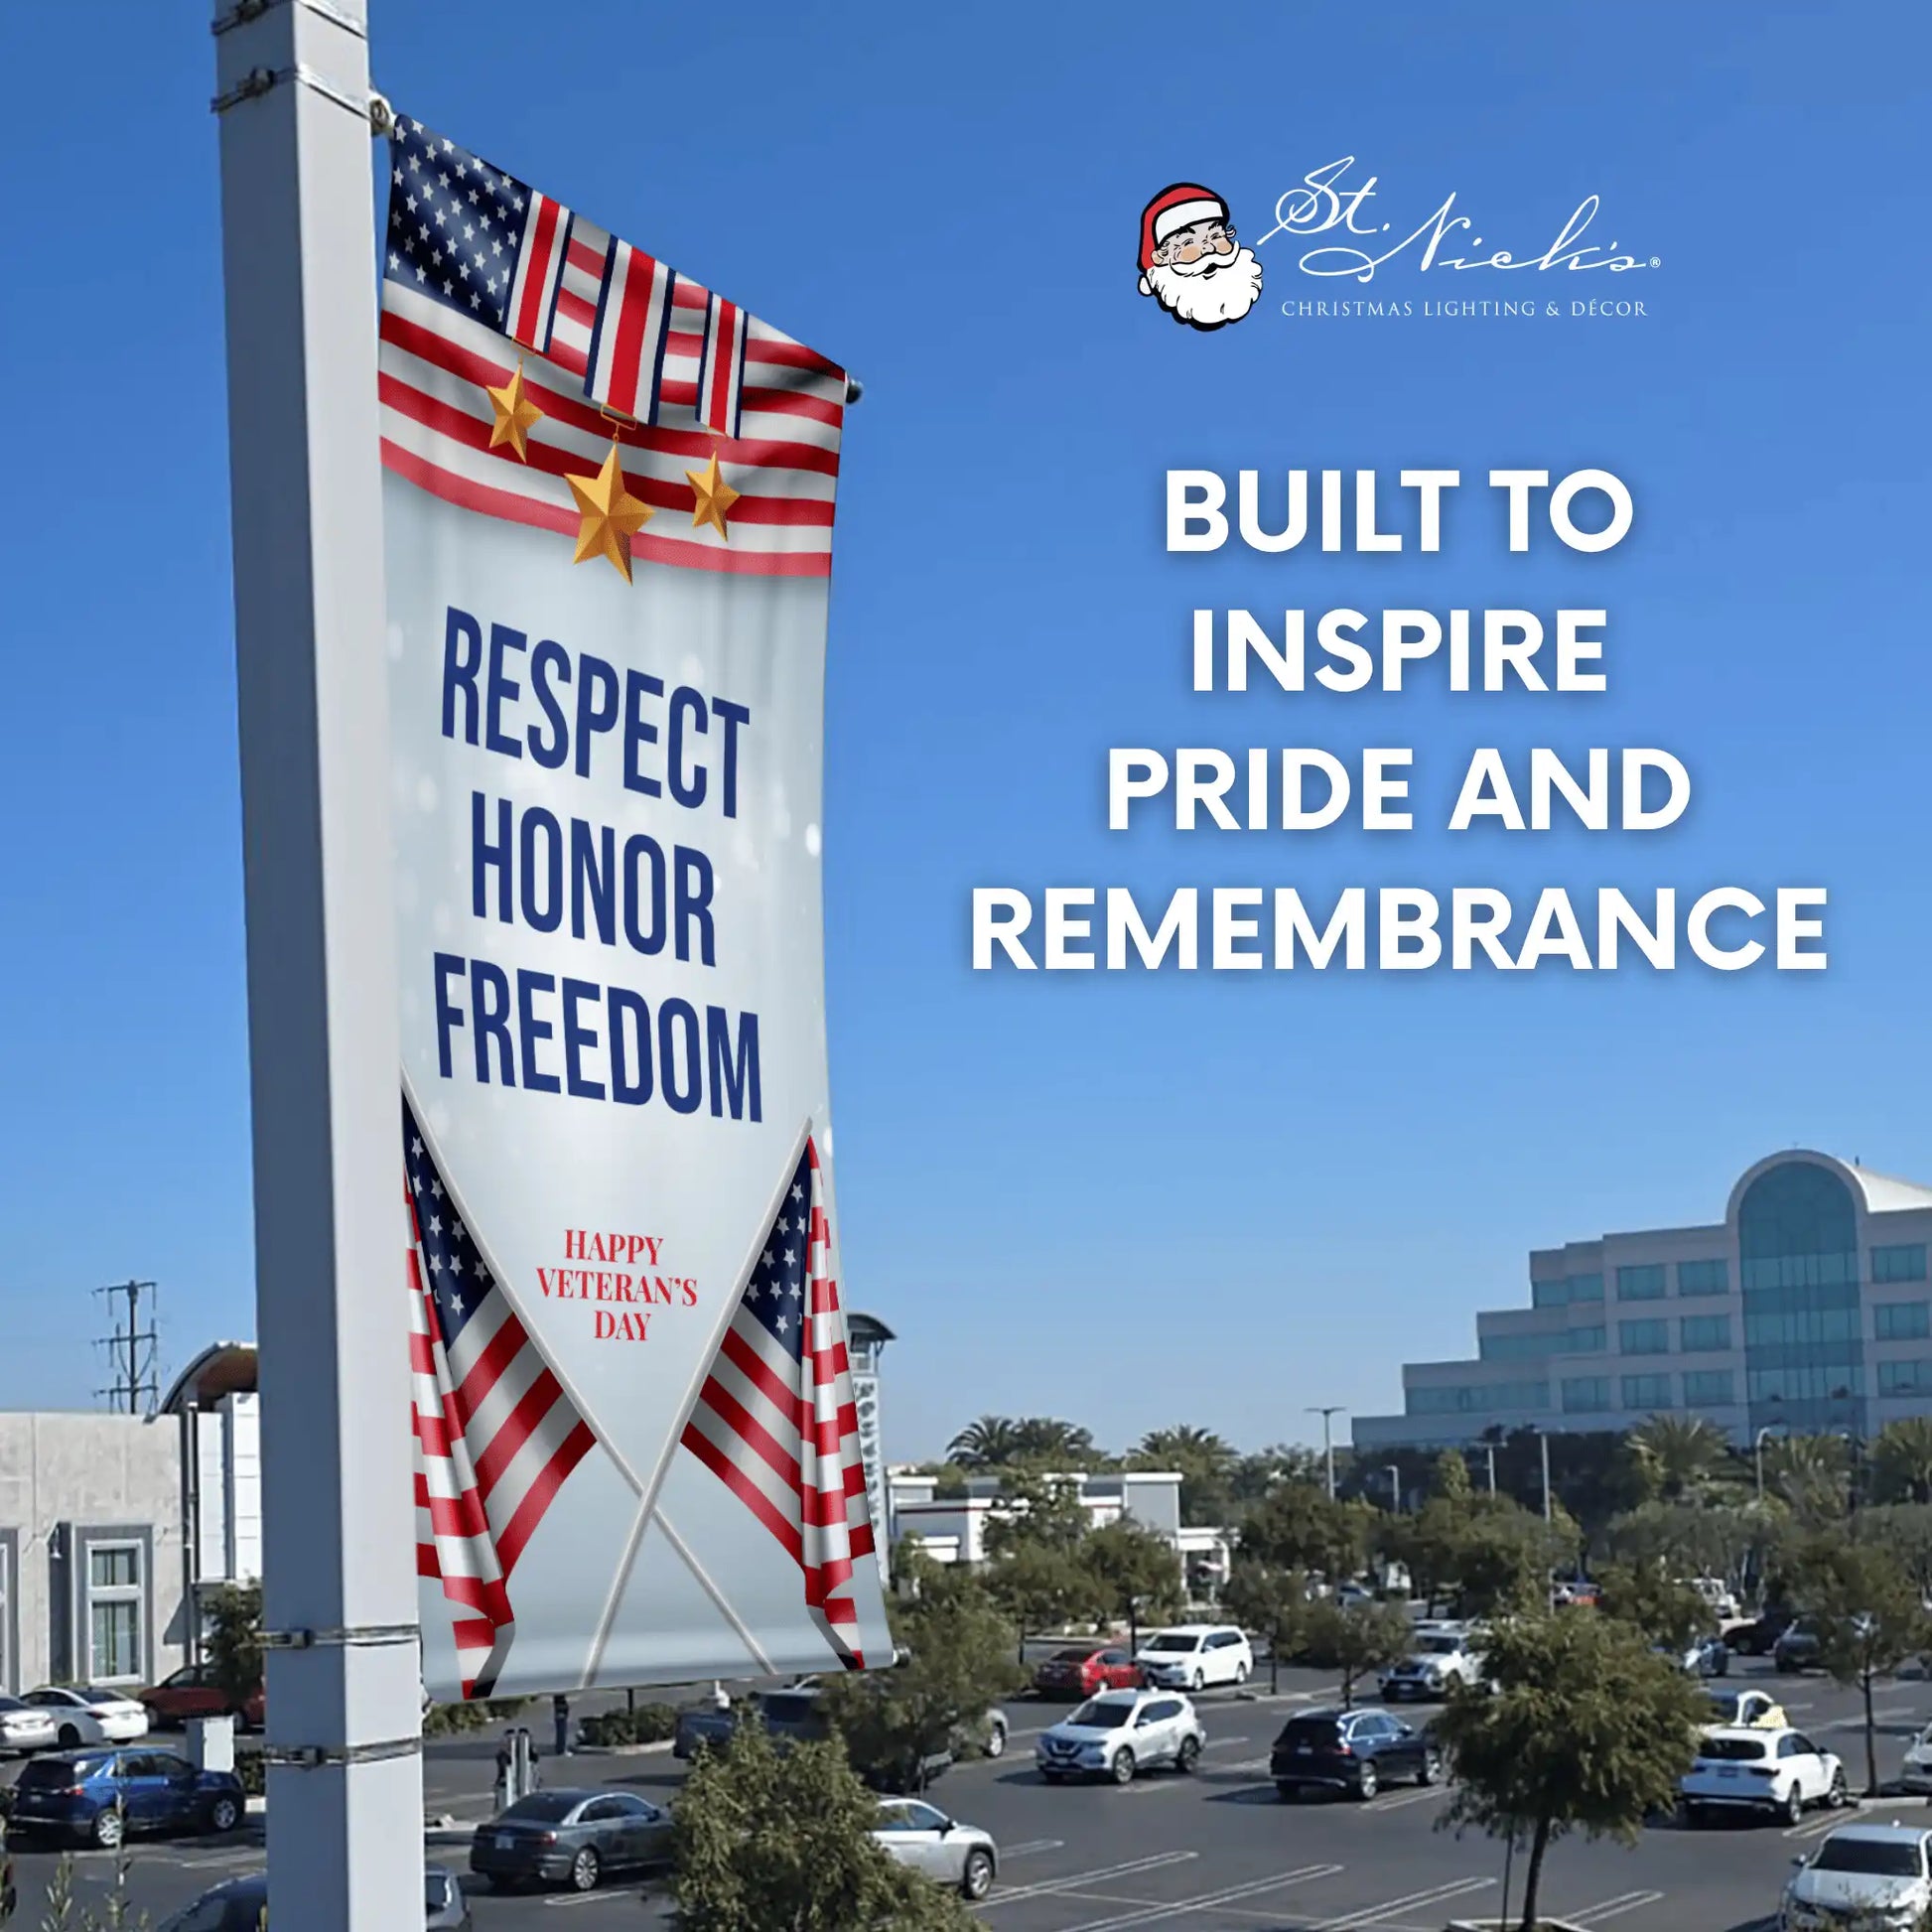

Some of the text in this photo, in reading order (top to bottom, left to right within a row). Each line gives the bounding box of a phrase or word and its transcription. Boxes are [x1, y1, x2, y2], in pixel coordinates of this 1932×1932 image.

[441, 606, 751, 820] RESPECT
[471, 790, 716, 968] HONOR
[433, 951, 763, 1124] FREEDOM
[536, 1267, 698, 1308] VETERAN'S
[564, 1228, 663, 1267] HAPPY
[594, 1310, 651, 1341] DAY
